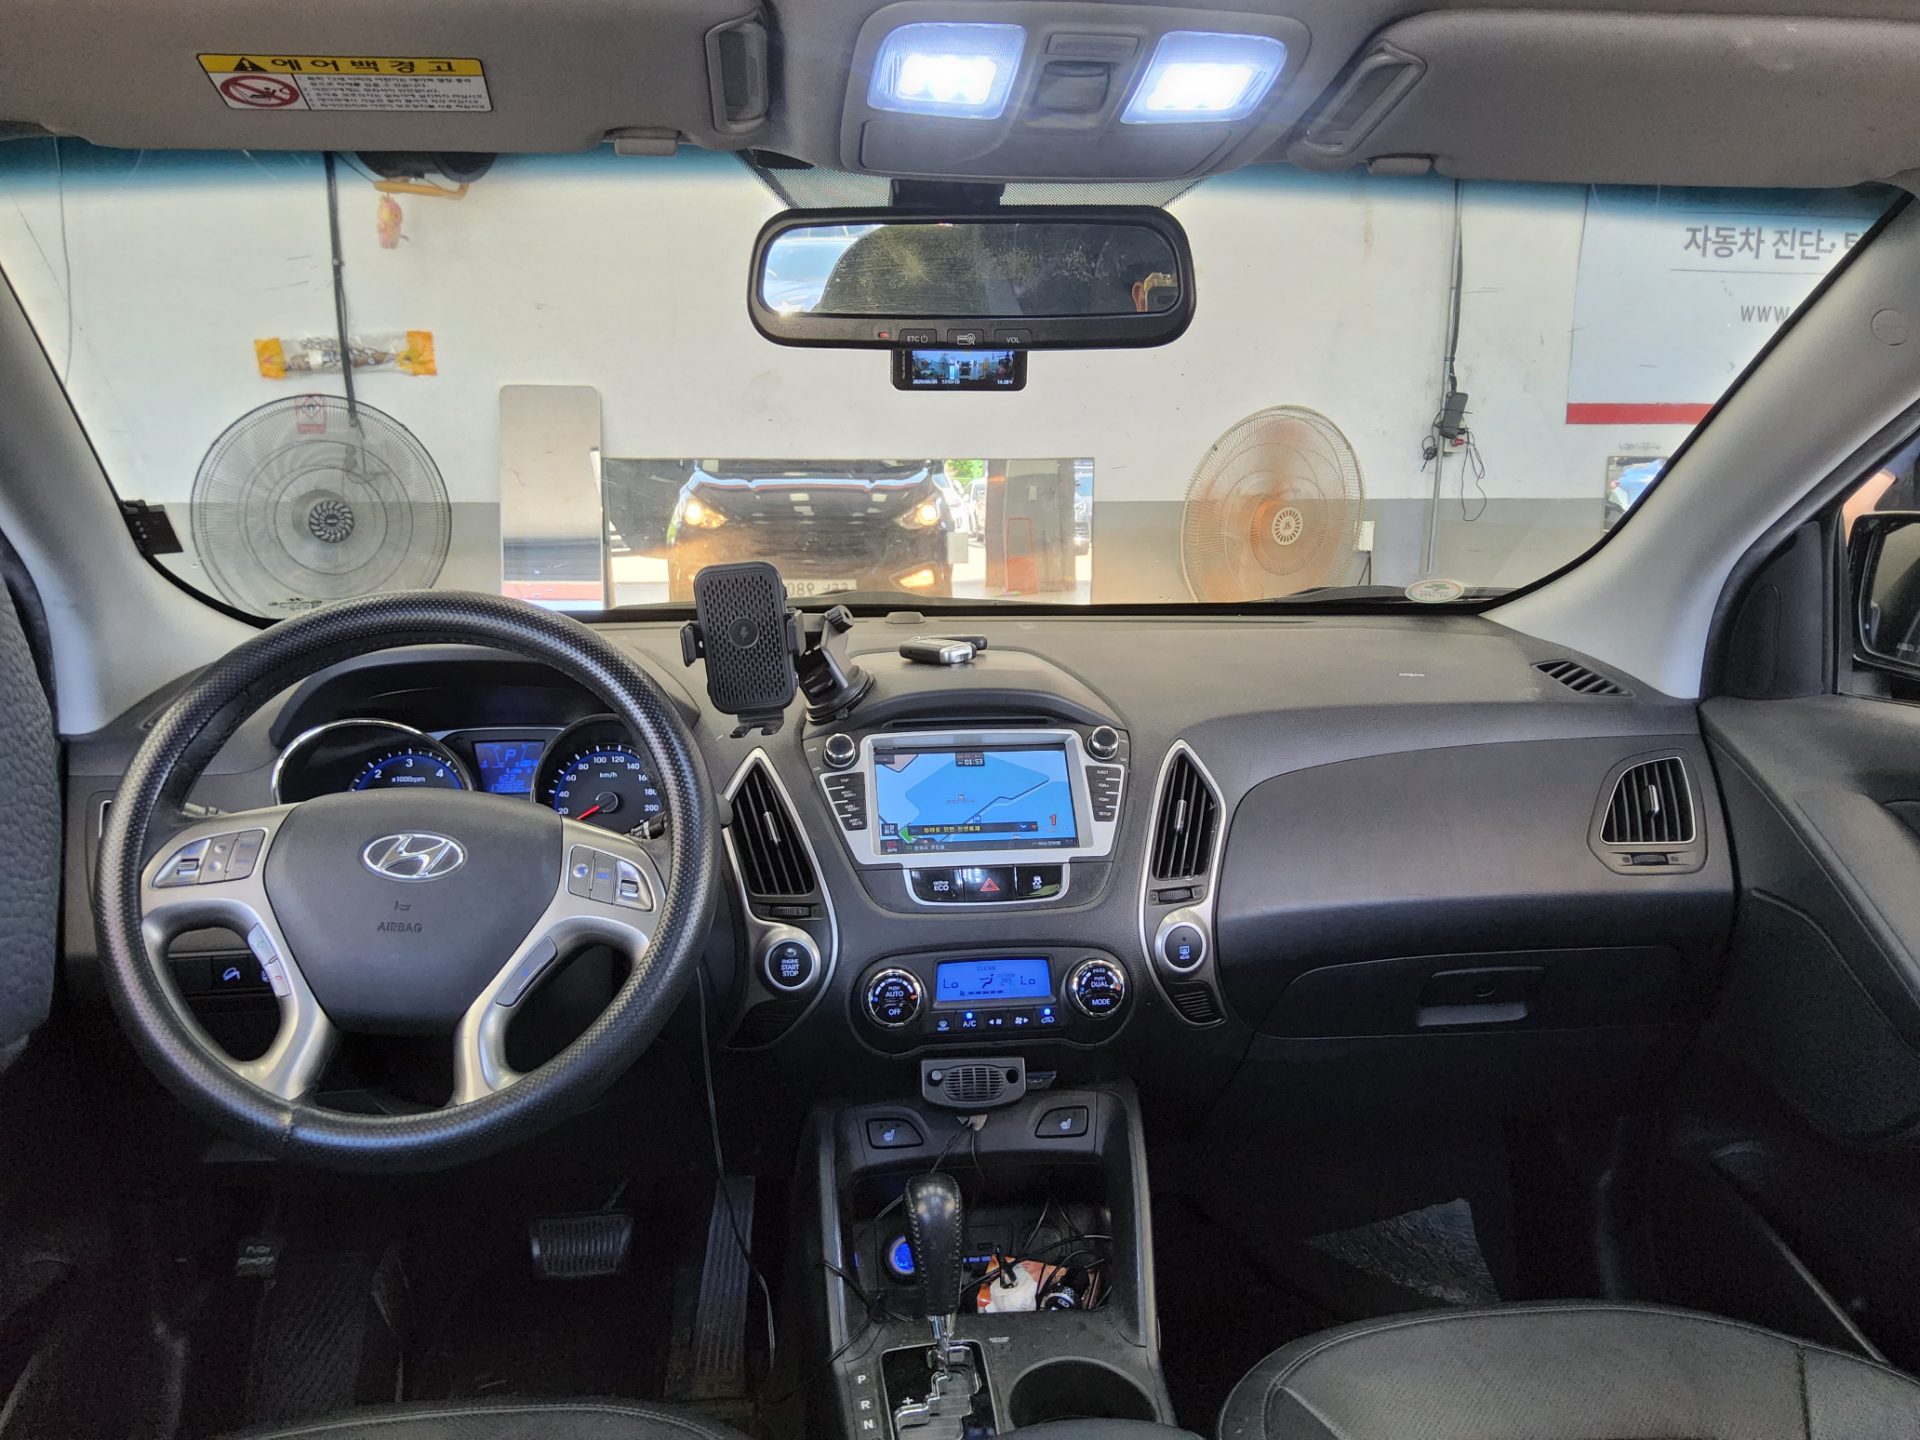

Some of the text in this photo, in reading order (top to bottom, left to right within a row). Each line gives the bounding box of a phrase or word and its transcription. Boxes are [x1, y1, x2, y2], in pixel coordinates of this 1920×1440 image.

[1684, 225, 1765, 259] 자동차
[907, 335, 920, 343] ETC
[1005, 336, 1021, 344] VOL
[405, 758, 414, 768] 3
[593, 755, 625, 764] 100 120
[626, 762, 640, 770] 140
[374, 769, 382, 779] 2
[435, 768, 445, 778] 4
[565, 774, 577, 782] 60
[558, 790, 570, 798] 40
[558, 807, 569, 815] 20
[644, 804, 659, 812] 200
[376, 921, 423, 933] AIRBAG
[780, 963, 800, 971] START
[782, 970, 799, 978] STOP
[1090, 980, 1110, 988] DUAL
[885, 990, 904, 998] AUTO
[1091, 998, 1111, 1006] MODE
[887, 1008, 902, 1016] OFF
[962, 1019, 977, 1028] A/C
[857, 1374, 867, 1384] P
[860, 1400, 871, 1410] R
[863, 1419, 874, 1430] N
